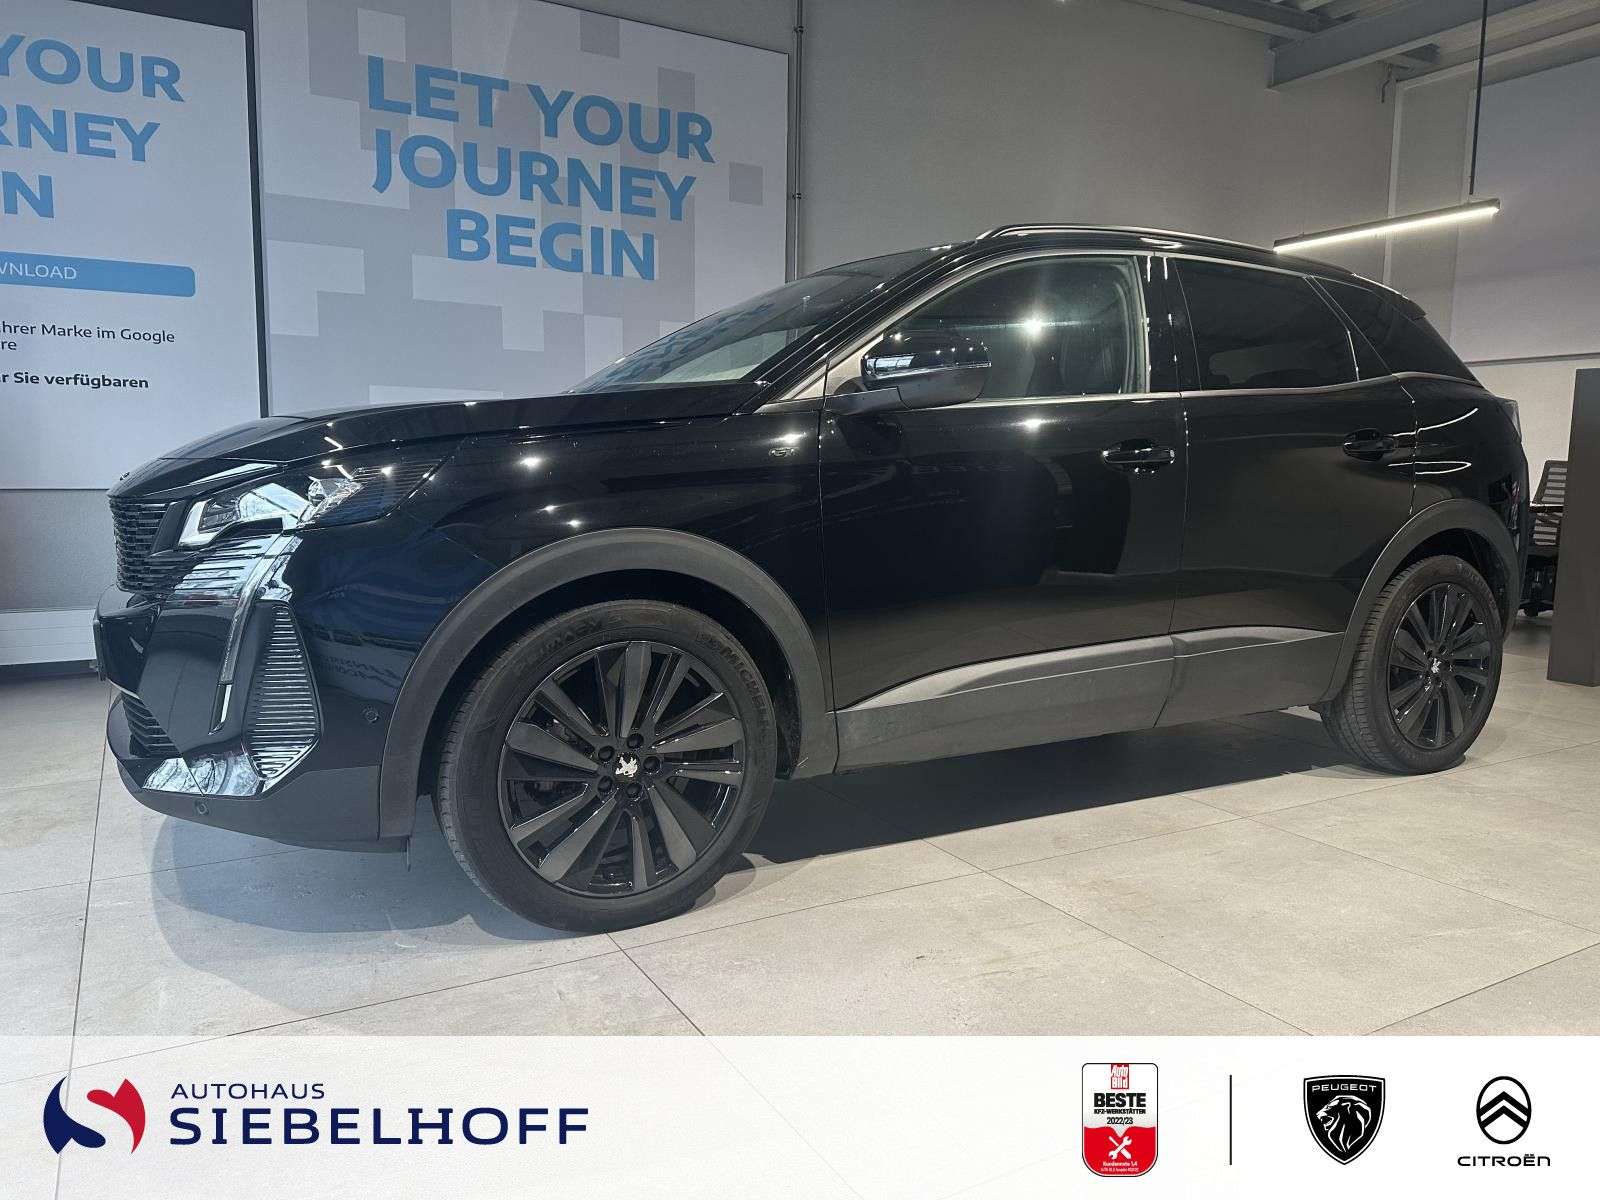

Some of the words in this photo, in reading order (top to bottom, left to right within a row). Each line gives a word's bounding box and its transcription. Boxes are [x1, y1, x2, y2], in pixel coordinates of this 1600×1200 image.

[0, 34, 185, 102] YOUR
[367, 54, 510, 128] LET
[526, 83, 716, 164] YOUR
[371, 128, 697, 222] JOURNEY
[446, 208, 656, 281] BEGIN
[0, 320, 36, 335] hrer
[41, 323, 92, 339] Marke
[96, 326, 117, 341] im
[120, 327, 176, 345] Google
[13, 371, 40, 384] Sie
[44, 373, 149, 390] verfügbaren
